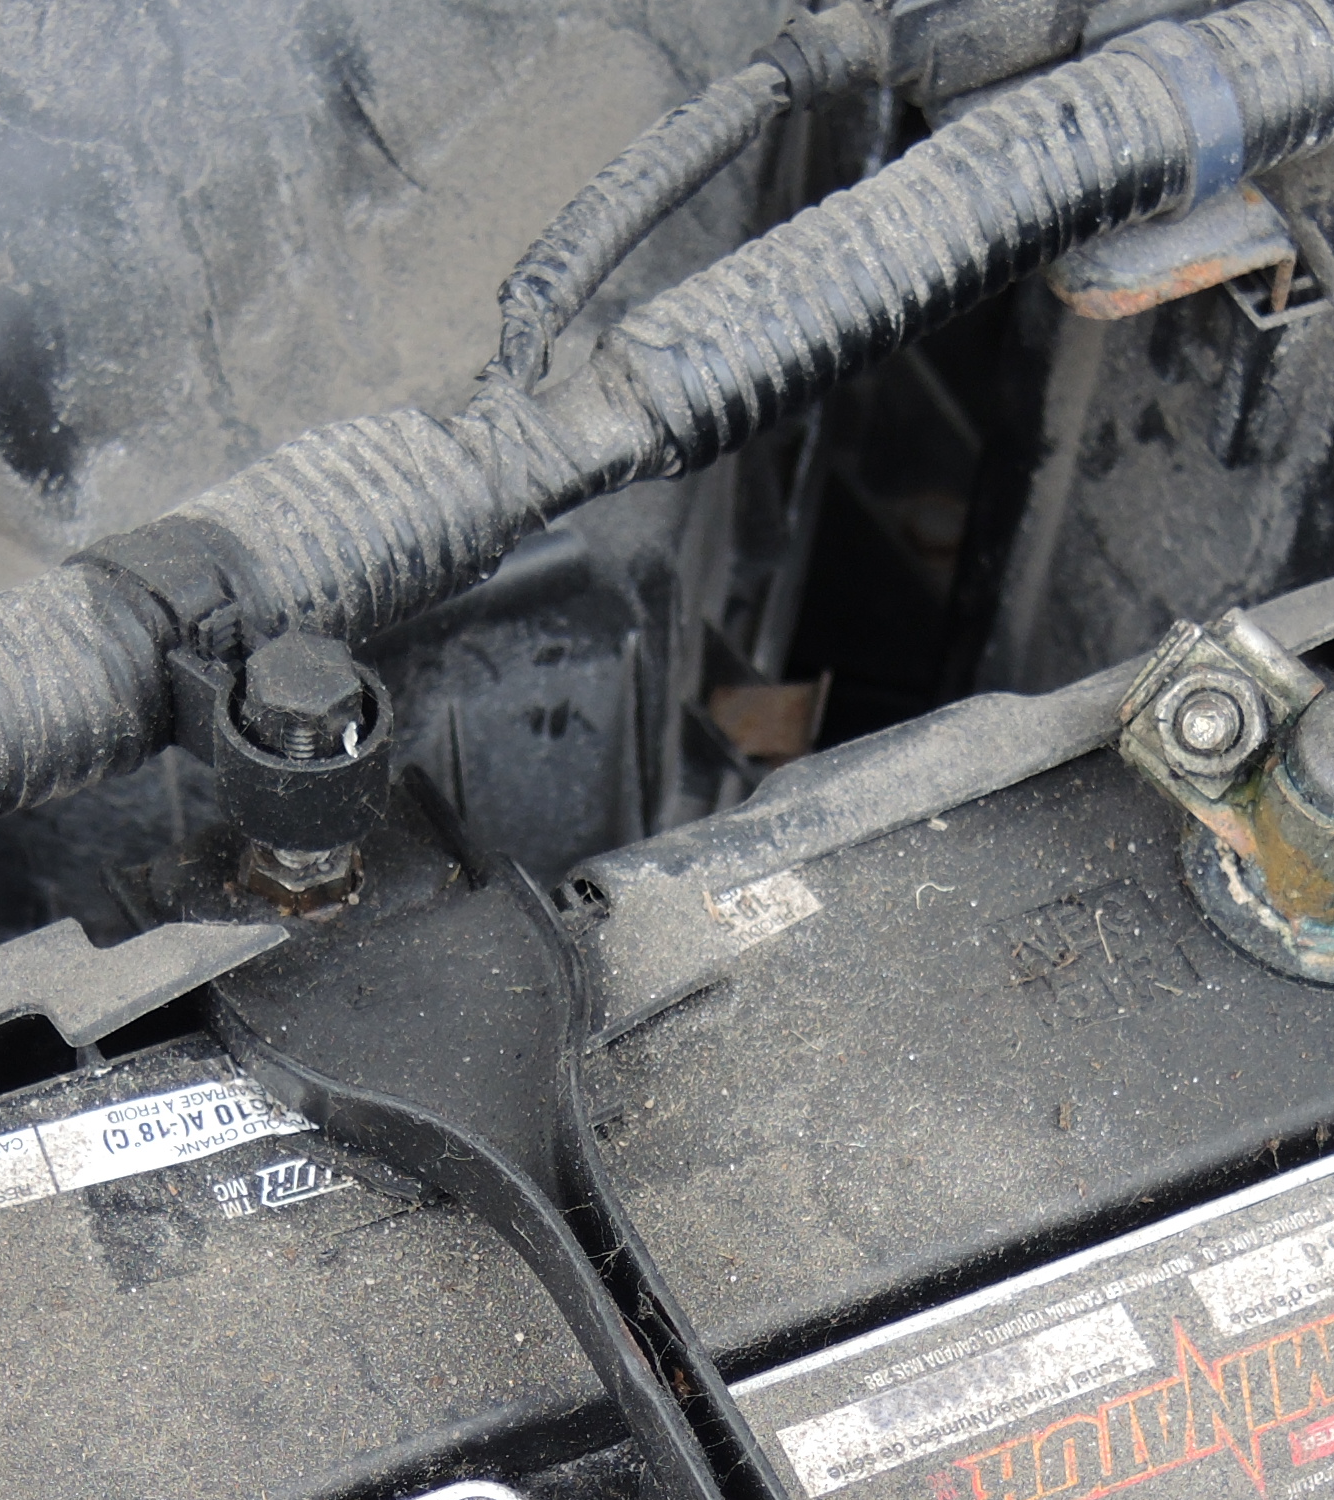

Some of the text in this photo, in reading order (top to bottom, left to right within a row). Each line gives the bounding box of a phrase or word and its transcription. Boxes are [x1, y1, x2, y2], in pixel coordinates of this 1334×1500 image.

[162, 1099, 176, 1115] À
[172, 1113, 291, 1156] OLD CRANK
[212, 1178, 247, 1201] MC
[222, 1197, 253, 1218] TM
[878, 1440, 908, 1462] de
[825, 1452, 878, 1483] série
